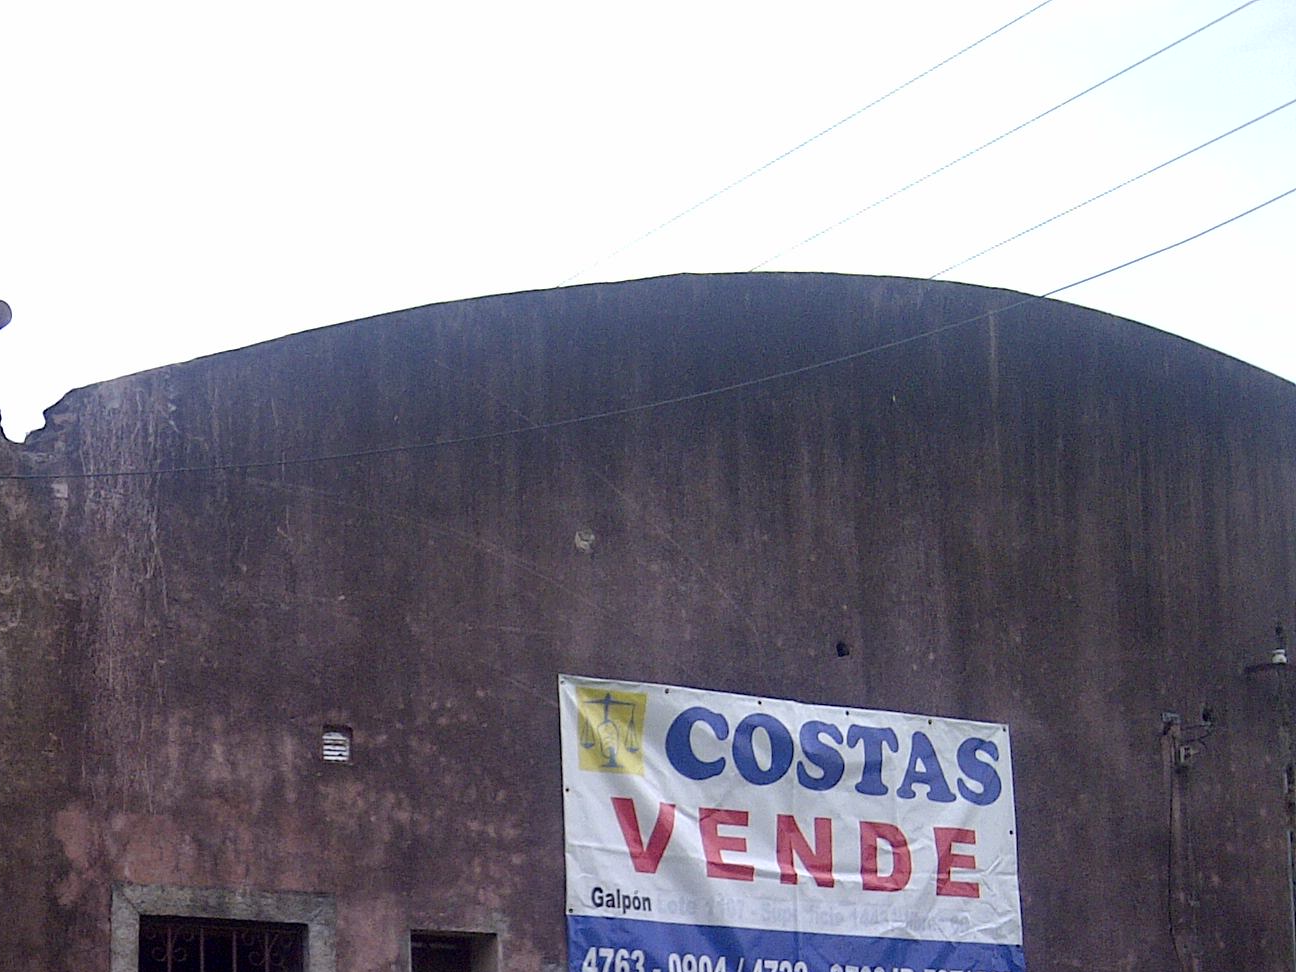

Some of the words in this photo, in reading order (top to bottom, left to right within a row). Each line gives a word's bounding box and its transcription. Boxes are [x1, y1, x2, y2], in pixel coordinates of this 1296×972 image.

[665, 706, 1002, 806] COSTAS
[610, 797, 980, 898] VENDE
[591, 886, 652, 915] Galpón
